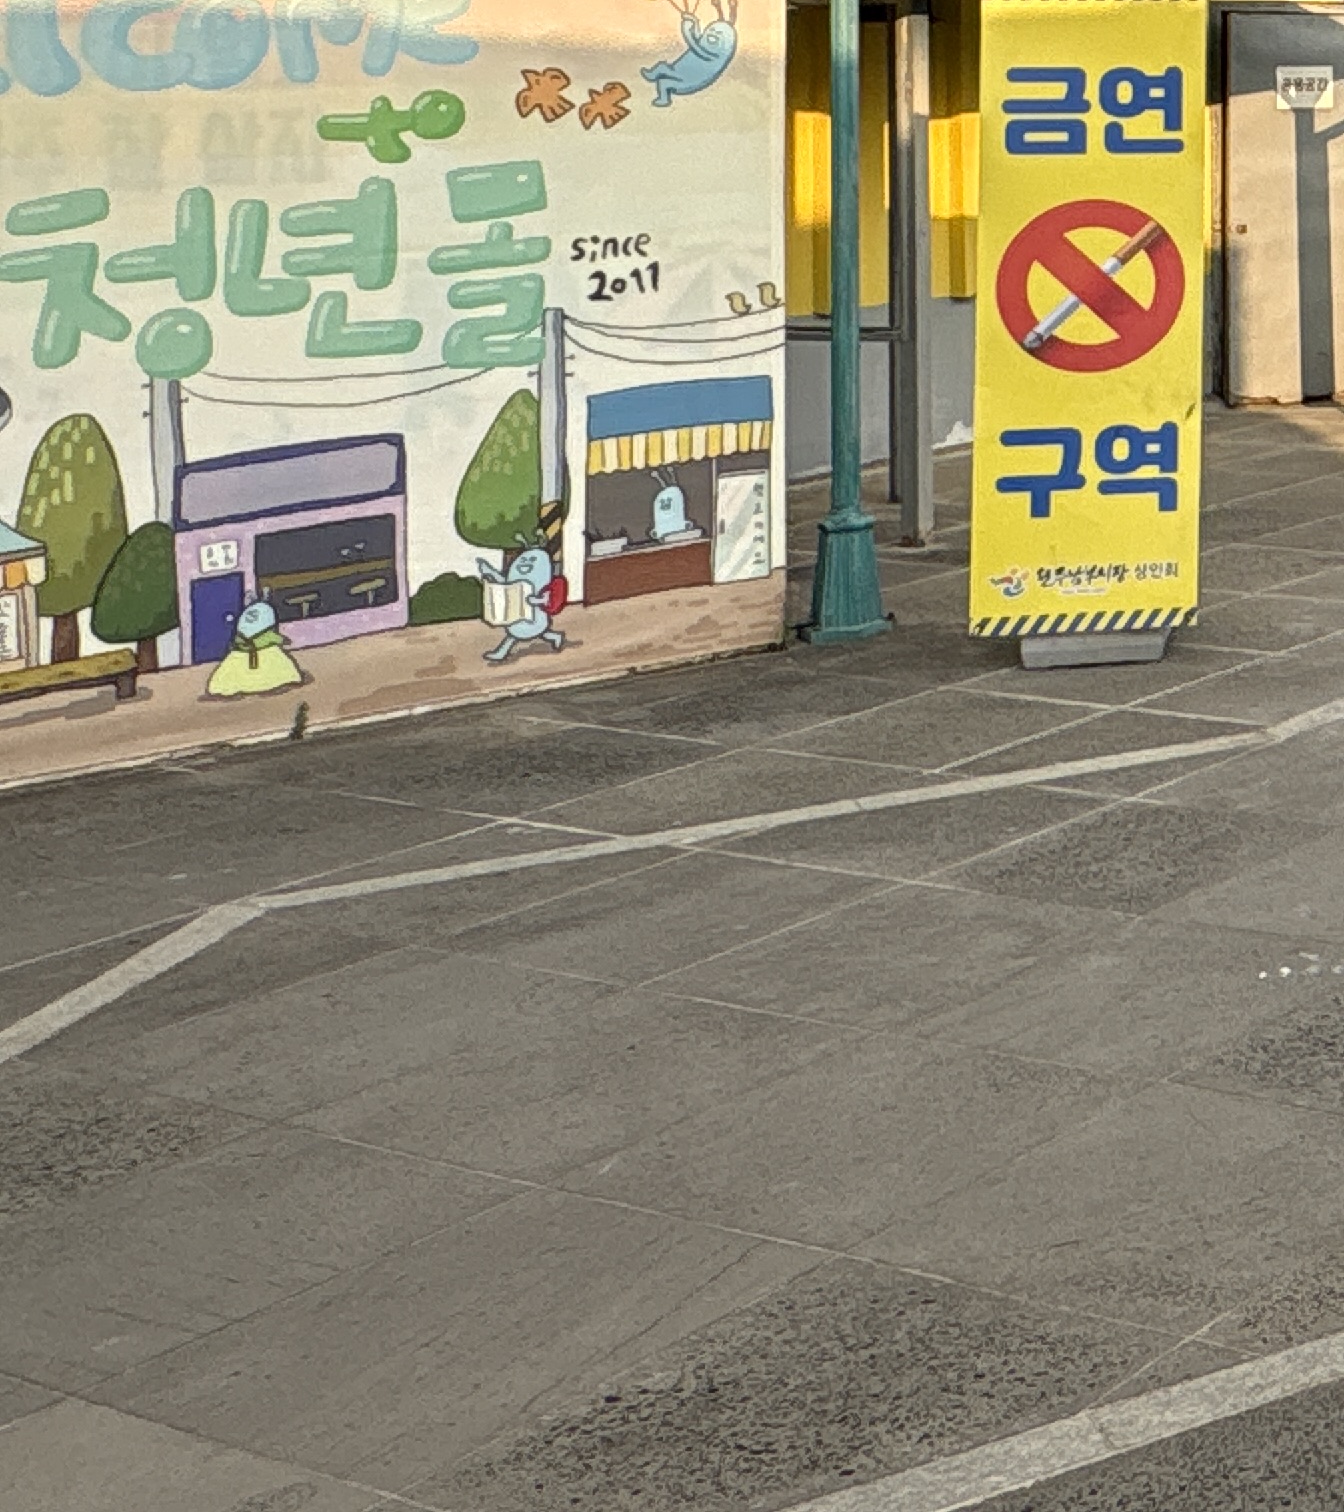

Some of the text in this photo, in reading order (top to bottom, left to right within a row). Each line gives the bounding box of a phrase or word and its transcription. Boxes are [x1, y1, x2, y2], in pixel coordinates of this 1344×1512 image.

[1001, 66, 1184, 155] 금연
[0, 161, 552, 380] 청년몰
[570, 232, 652, 263] since
[994, 422, 1178, 518] 구역
[1134, 561, 1179, 581] 상인회
